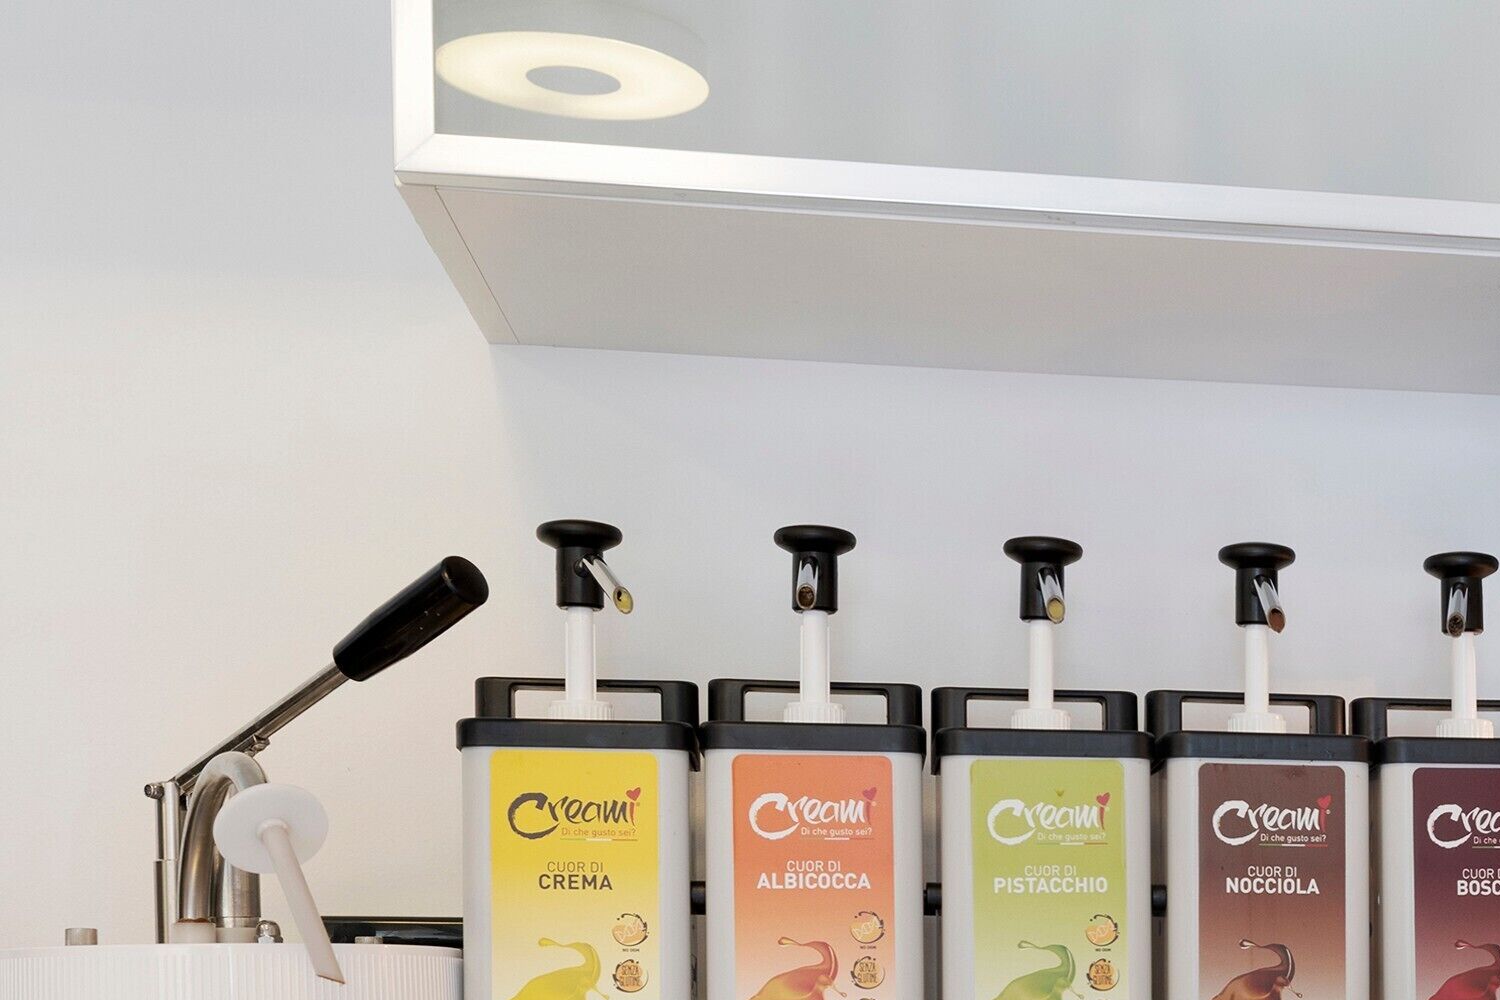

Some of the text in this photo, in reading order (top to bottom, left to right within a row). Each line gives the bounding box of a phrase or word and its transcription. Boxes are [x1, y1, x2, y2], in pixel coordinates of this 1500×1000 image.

[508, 787, 641, 840] Creami
[748, 787, 877, 840] Creami
[987, 792, 1111, 846] Creami
[1212, 795, 1332, 846] Creami
[561, 827, 636, 838] Di che gusto sei?
[801, 826, 873, 837] Di che gusto sei?
[1260, 833, 1327, 844] Di che gusto sei?
[1473, 836, 1481, 844] Di
[1483, 836, 1497, 844] che
[547, 861, 604, 873] CUOR DI
[786, 860, 841, 872] CUOR DI
[1024, 865, 1077, 876] CUOR DI
[1247, 865, 1297, 877] CUOR DI
[1462, 868, 1495, 880] CUOR
[538, 874, 613, 890] CREMA
[756, 872, 871, 889] ALBICOCCA
[993, 877, 1108, 893] PISTACCHIO
[1225, 877, 1320, 894] NOCCIOLA
